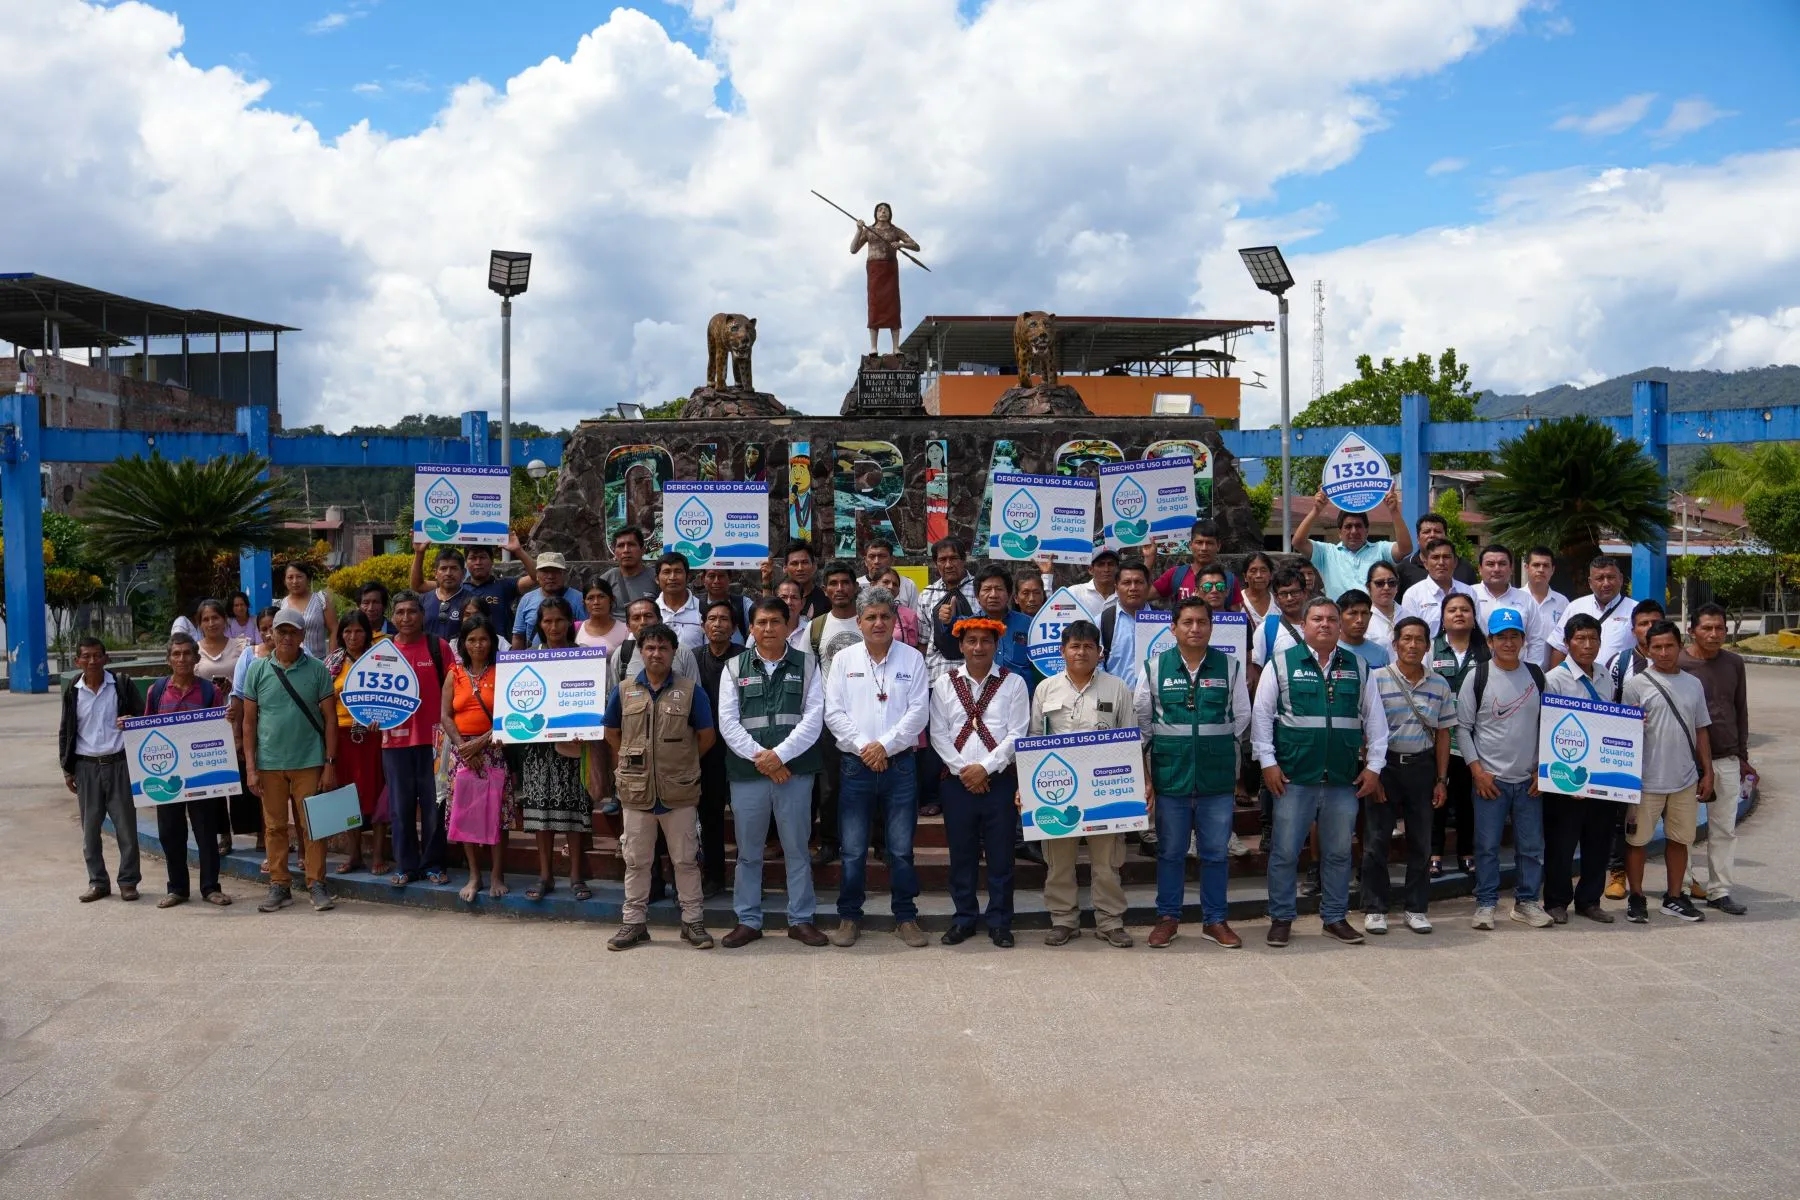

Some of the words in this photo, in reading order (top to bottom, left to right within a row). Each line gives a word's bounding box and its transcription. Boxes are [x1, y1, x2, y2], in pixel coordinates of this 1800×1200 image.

[1333, 461, 1379, 479] 1330
[1327, 481, 1388, 494] BENEFICIARIOS
[1119, 490, 1138, 498] agua
[429, 496, 455, 504] formal
[1116, 496, 1142, 505] formal
[1157, 495, 1188, 504] Usuarios
[1007, 509, 1036, 518] formal
[679, 518, 708, 526] formal
[1051, 516, 1086, 524] Usuarios
[358, 671, 409, 691] 1330
[514, 680, 538, 688] agua
[511, 687, 542, 696] formal
[558, 690, 596, 698] Usuarios
[346, 695, 414, 709] BENEFICIARIOS
[1545, 697, 1580, 707] DERECHO
[1621, 708, 1641, 716] AGUA
[125, 717, 161, 728] DERECHO
[1559, 728, 1581, 737] agua
[1018, 739, 1060, 748] DERECHO
[1556, 735, 1584, 747] formal
[145, 744, 168, 753] agua
[1600, 747, 1634, 758] Usuarios
[143, 751, 174, 761] formal
[190, 749, 227, 758] Usuarios
[206, 758, 227, 767] agua
[1613, 759, 1632, 767] agua
[1040, 769, 1067, 779] agua
[1037, 777, 1072, 788] formal
[1092, 776, 1134, 787] Usuarios
[1094, 788, 1106, 796] de
[1109, 786, 1134, 796] agua
